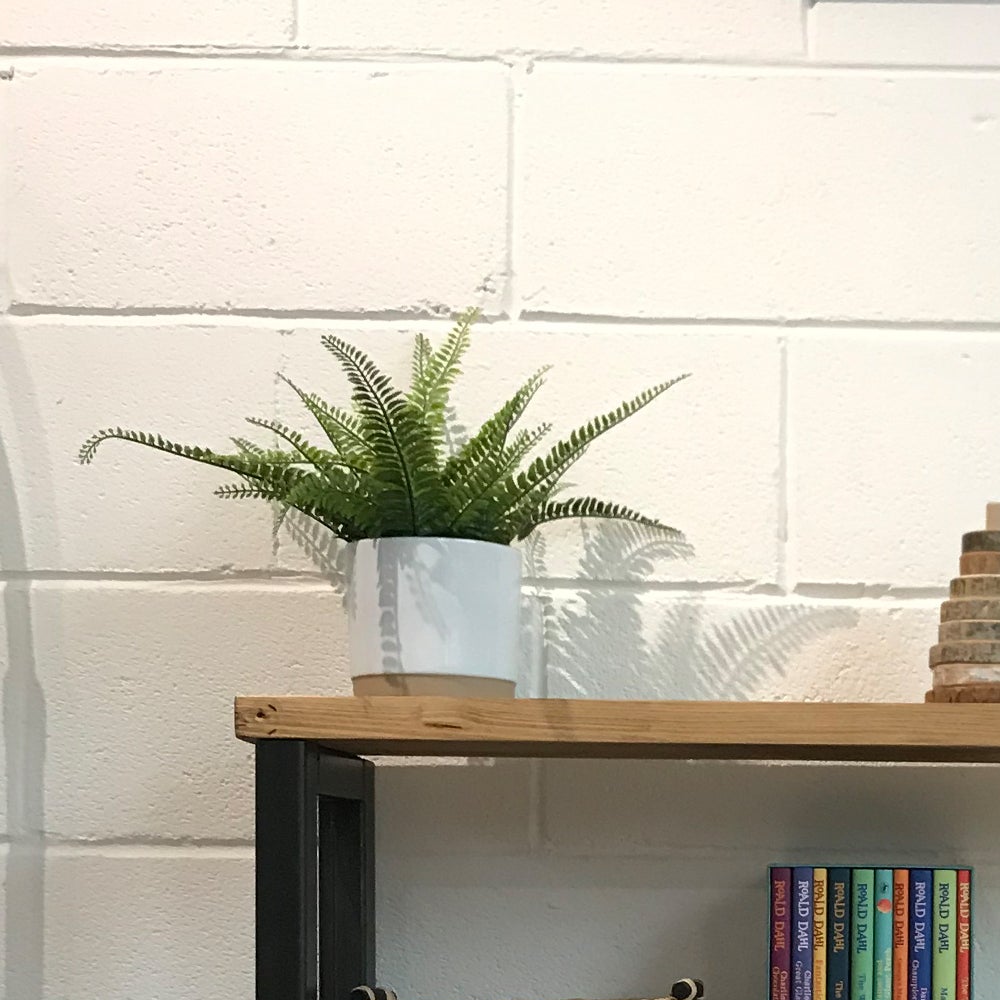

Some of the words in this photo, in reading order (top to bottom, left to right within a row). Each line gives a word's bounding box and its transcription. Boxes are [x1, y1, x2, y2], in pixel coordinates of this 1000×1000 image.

[774, 880, 786, 917] ROALD
[798, 880, 810, 917] ROALD
[813, 879, 824, 916] ROALD
[834, 882, 845, 918] ROALD
[857, 883, 868, 919] ROALD
[895, 883, 904, 917] ROALD
[915, 882, 926, 918] ROALD
[939, 883, 949, 919] ROALD
[960, 882, 969, 919] ROALD
[774, 921, 785, 952] DAHL
[797, 921, 809, 952] DAHL
[813, 920, 824, 951] DAHL
[833, 922, 844, 953] DAHL
[857, 924, 867, 954] DAHL
[895, 921, 904, 949] DAHL
[915, 922, 925, 953] DAHL
[938, 924, 949, 954] DAHL
[960, 923, 969, 953] DAHL
[780, 970, 788, 1000] Charlie
[795, 961, 803, 984] Great
[803, 970, 811, 1000] Charlie
[858, 975, 866, 991] The
[835, 980, 843, 998] The
